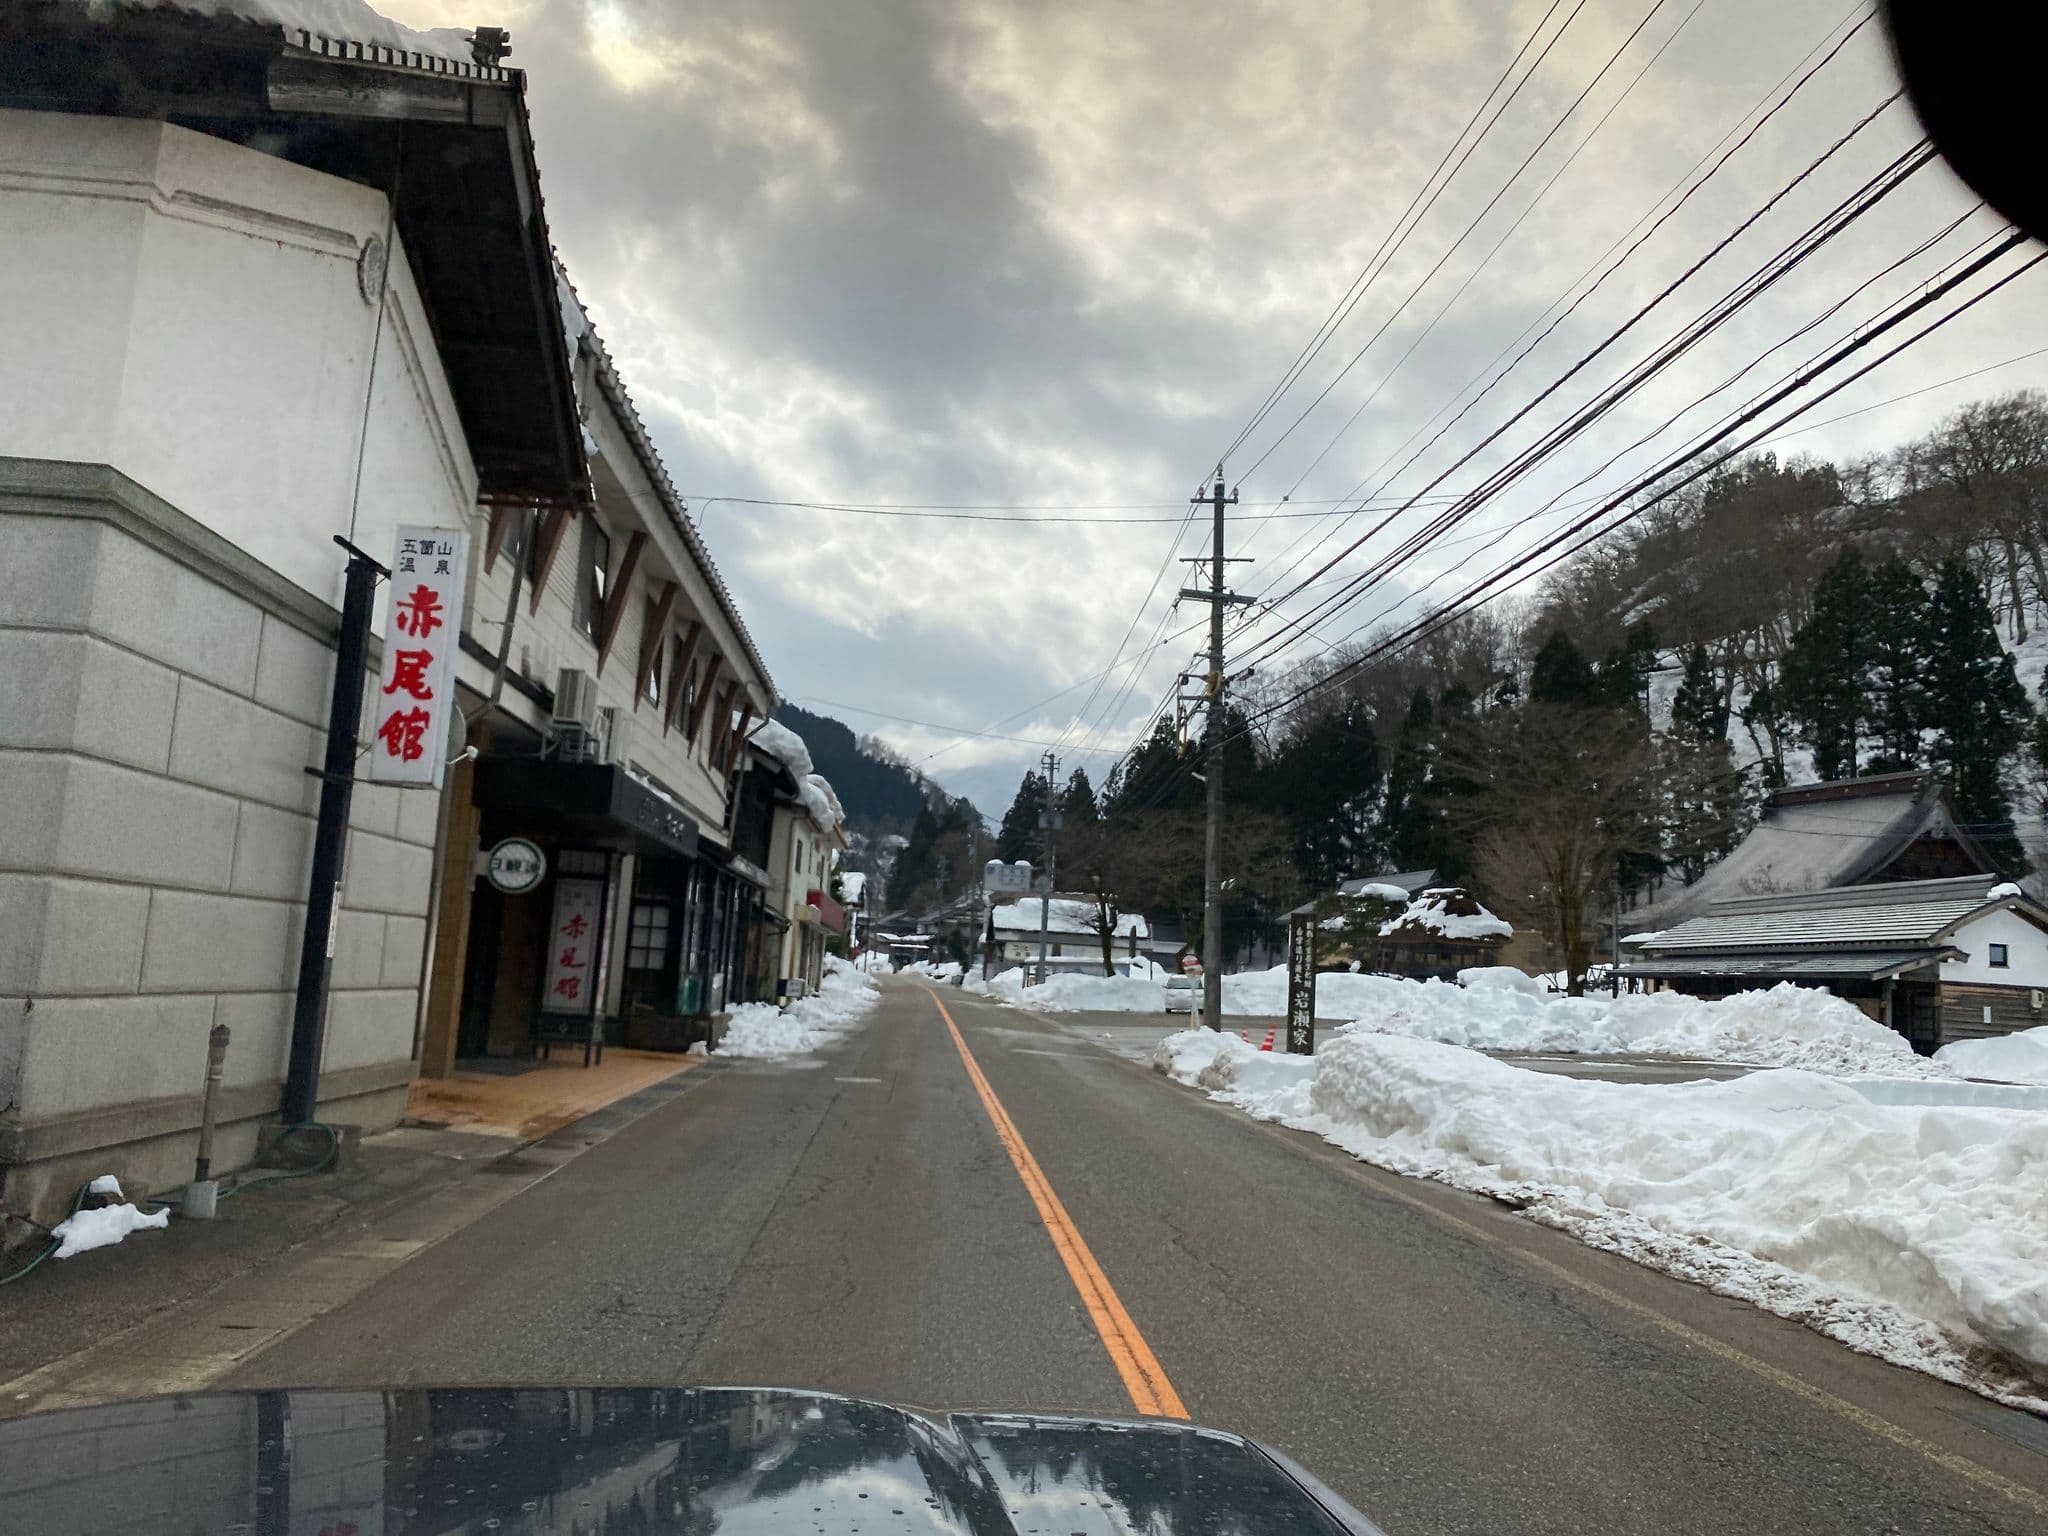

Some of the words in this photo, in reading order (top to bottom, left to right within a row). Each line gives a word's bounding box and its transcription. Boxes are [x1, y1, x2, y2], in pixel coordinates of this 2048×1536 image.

[400, 538, 453, 556] 五箇山
[378, 584, 444, 763] 赤尾館
